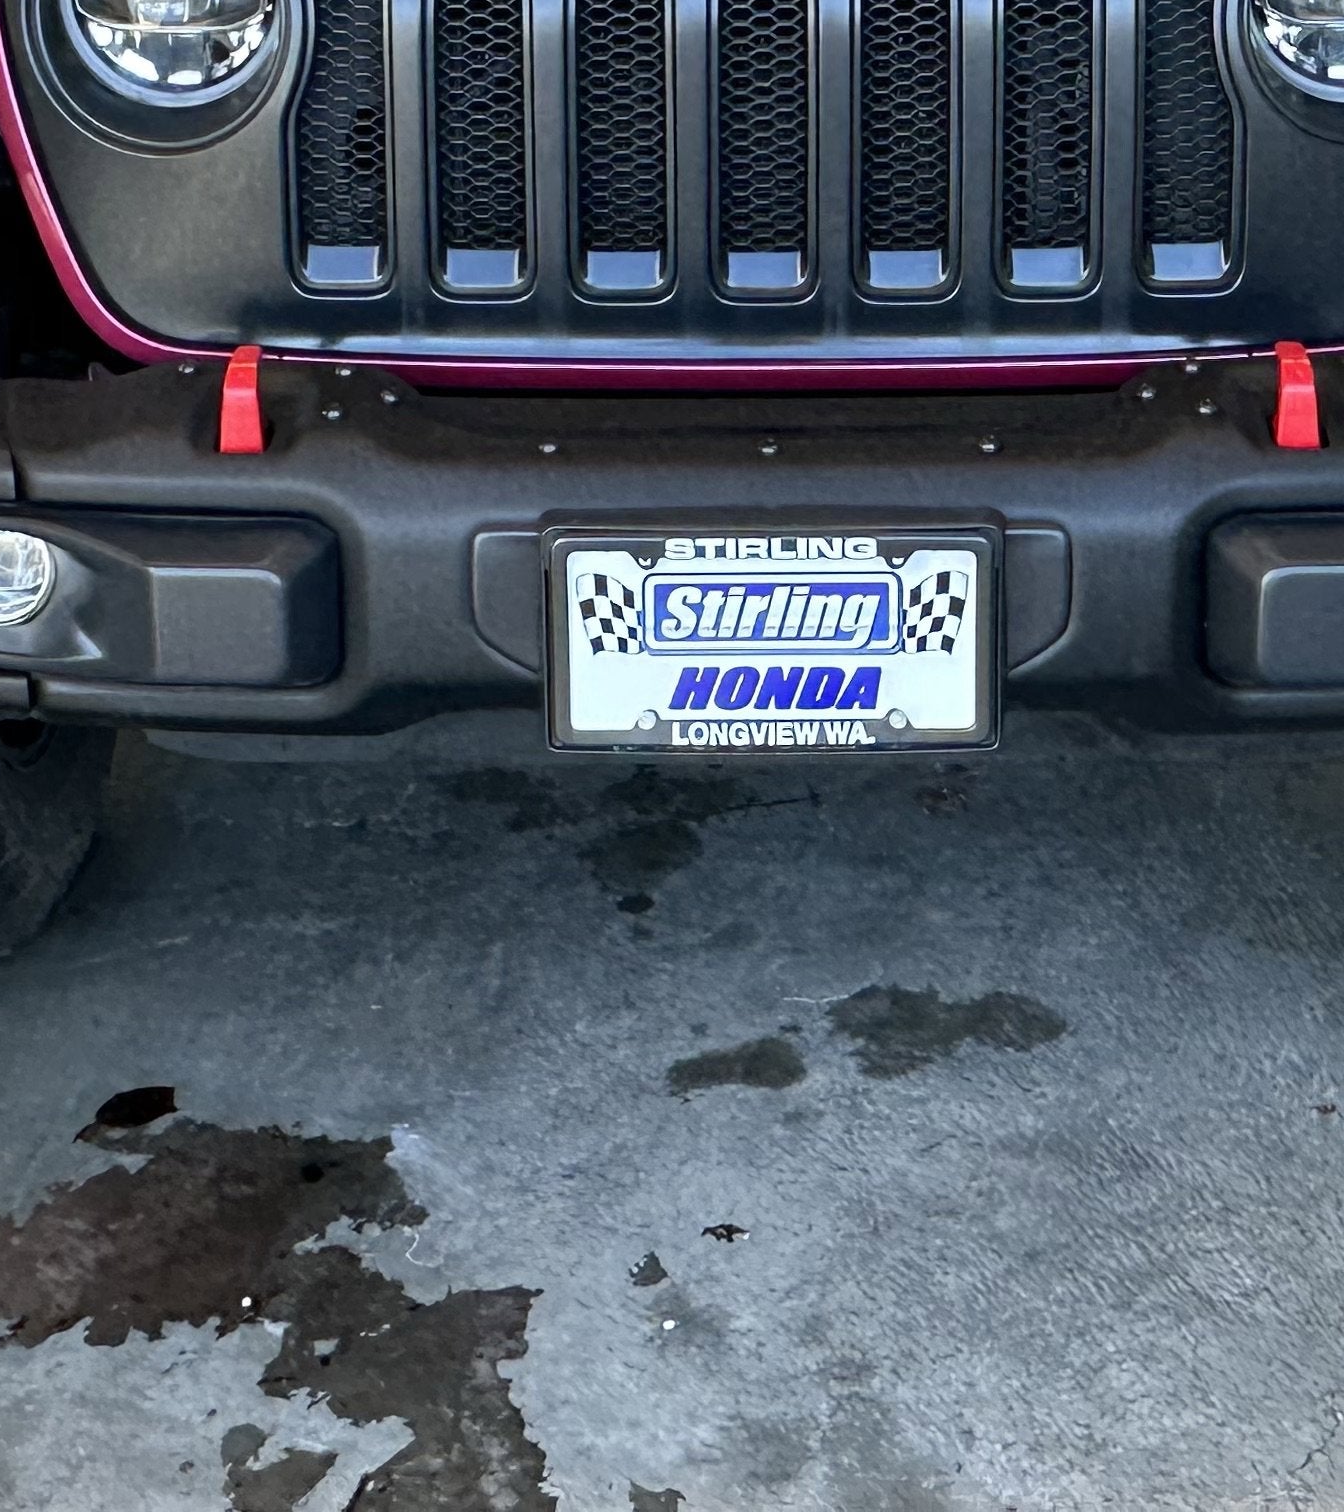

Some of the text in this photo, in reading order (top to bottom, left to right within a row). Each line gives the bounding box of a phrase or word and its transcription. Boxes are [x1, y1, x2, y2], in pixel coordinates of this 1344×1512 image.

[664, 537, 878, 560] STIRLING
[660, 584, 880, 650] Stirling
[668, 666, 882, 710] HONDA
[671, 721, 821, 746] LONGVIEW
